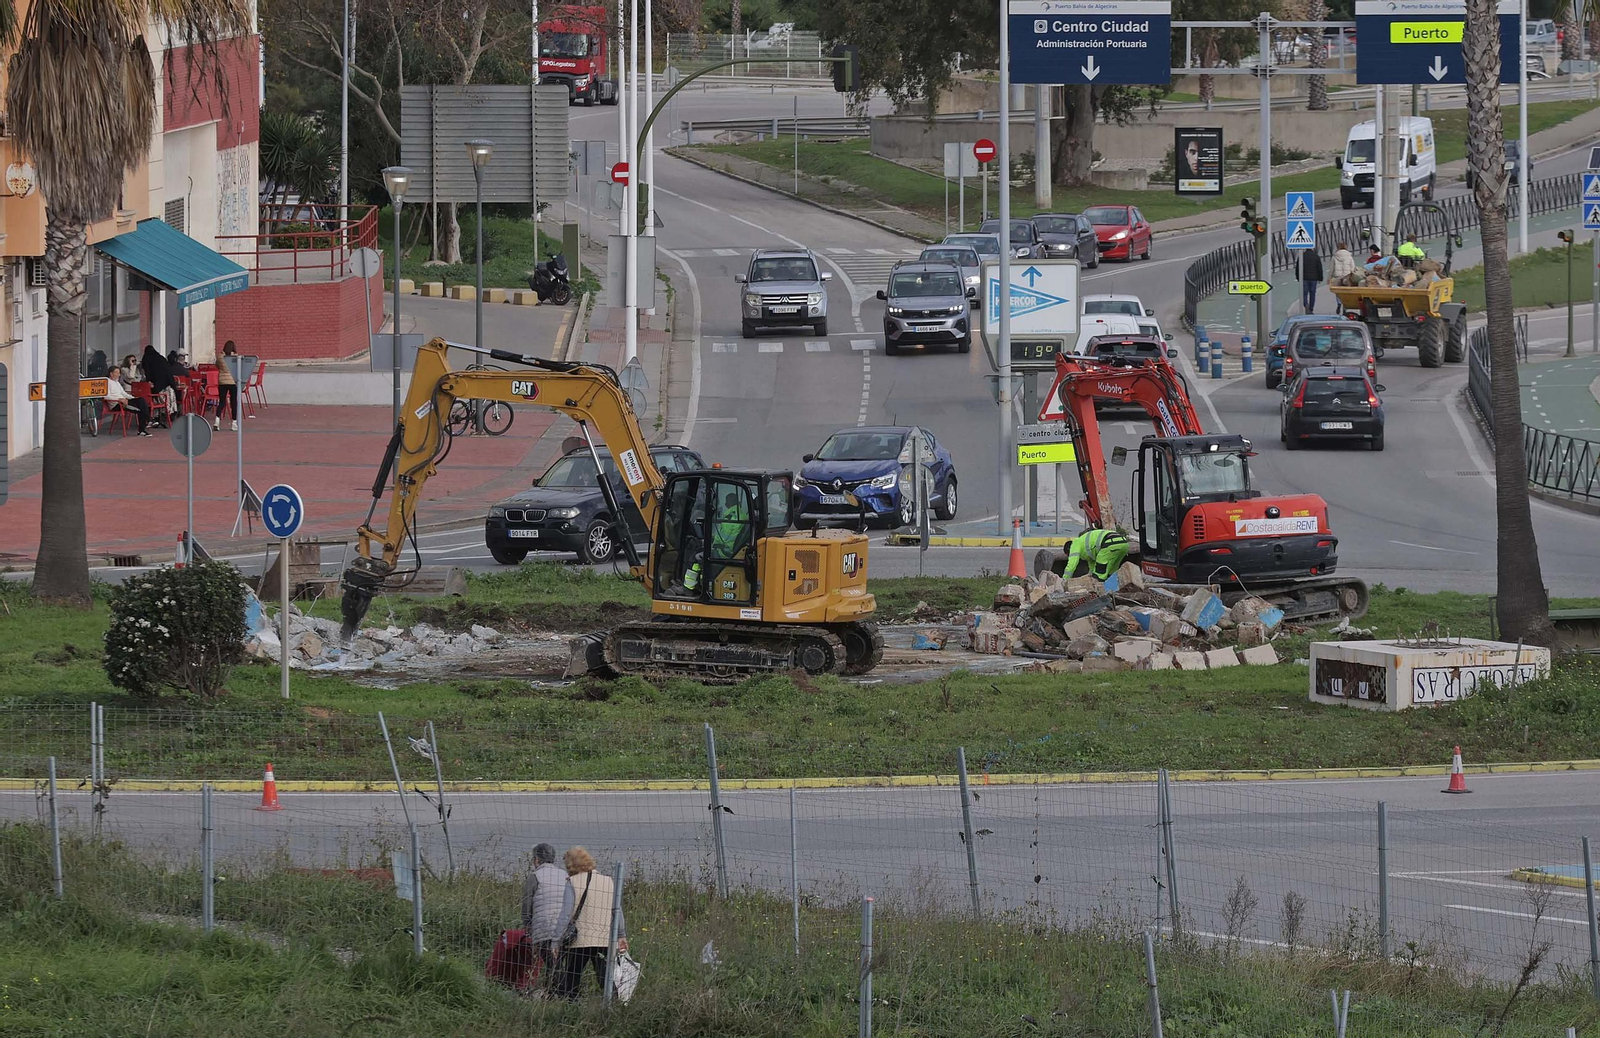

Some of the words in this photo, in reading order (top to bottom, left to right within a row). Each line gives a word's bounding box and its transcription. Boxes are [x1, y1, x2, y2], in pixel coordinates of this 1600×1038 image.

[1052, 20, 1098, 33] Centro
[1101, 20, 1149, 33] Ciudad
[1404, 27, 1449, 39] Puerto
[1036, 39, 1104, 48] Administración
[1106, 39, 1147, 48] Portuaria
[512, 380, 533, 396] CAT
[1097, 381, 1122, 394] Kubota
[1158, 400, 1171, 425] Costa
[627, 452, 642, 480] emerent
[843, 553, 856, 573] CAT
[669, 603, 693, 612] 5196
